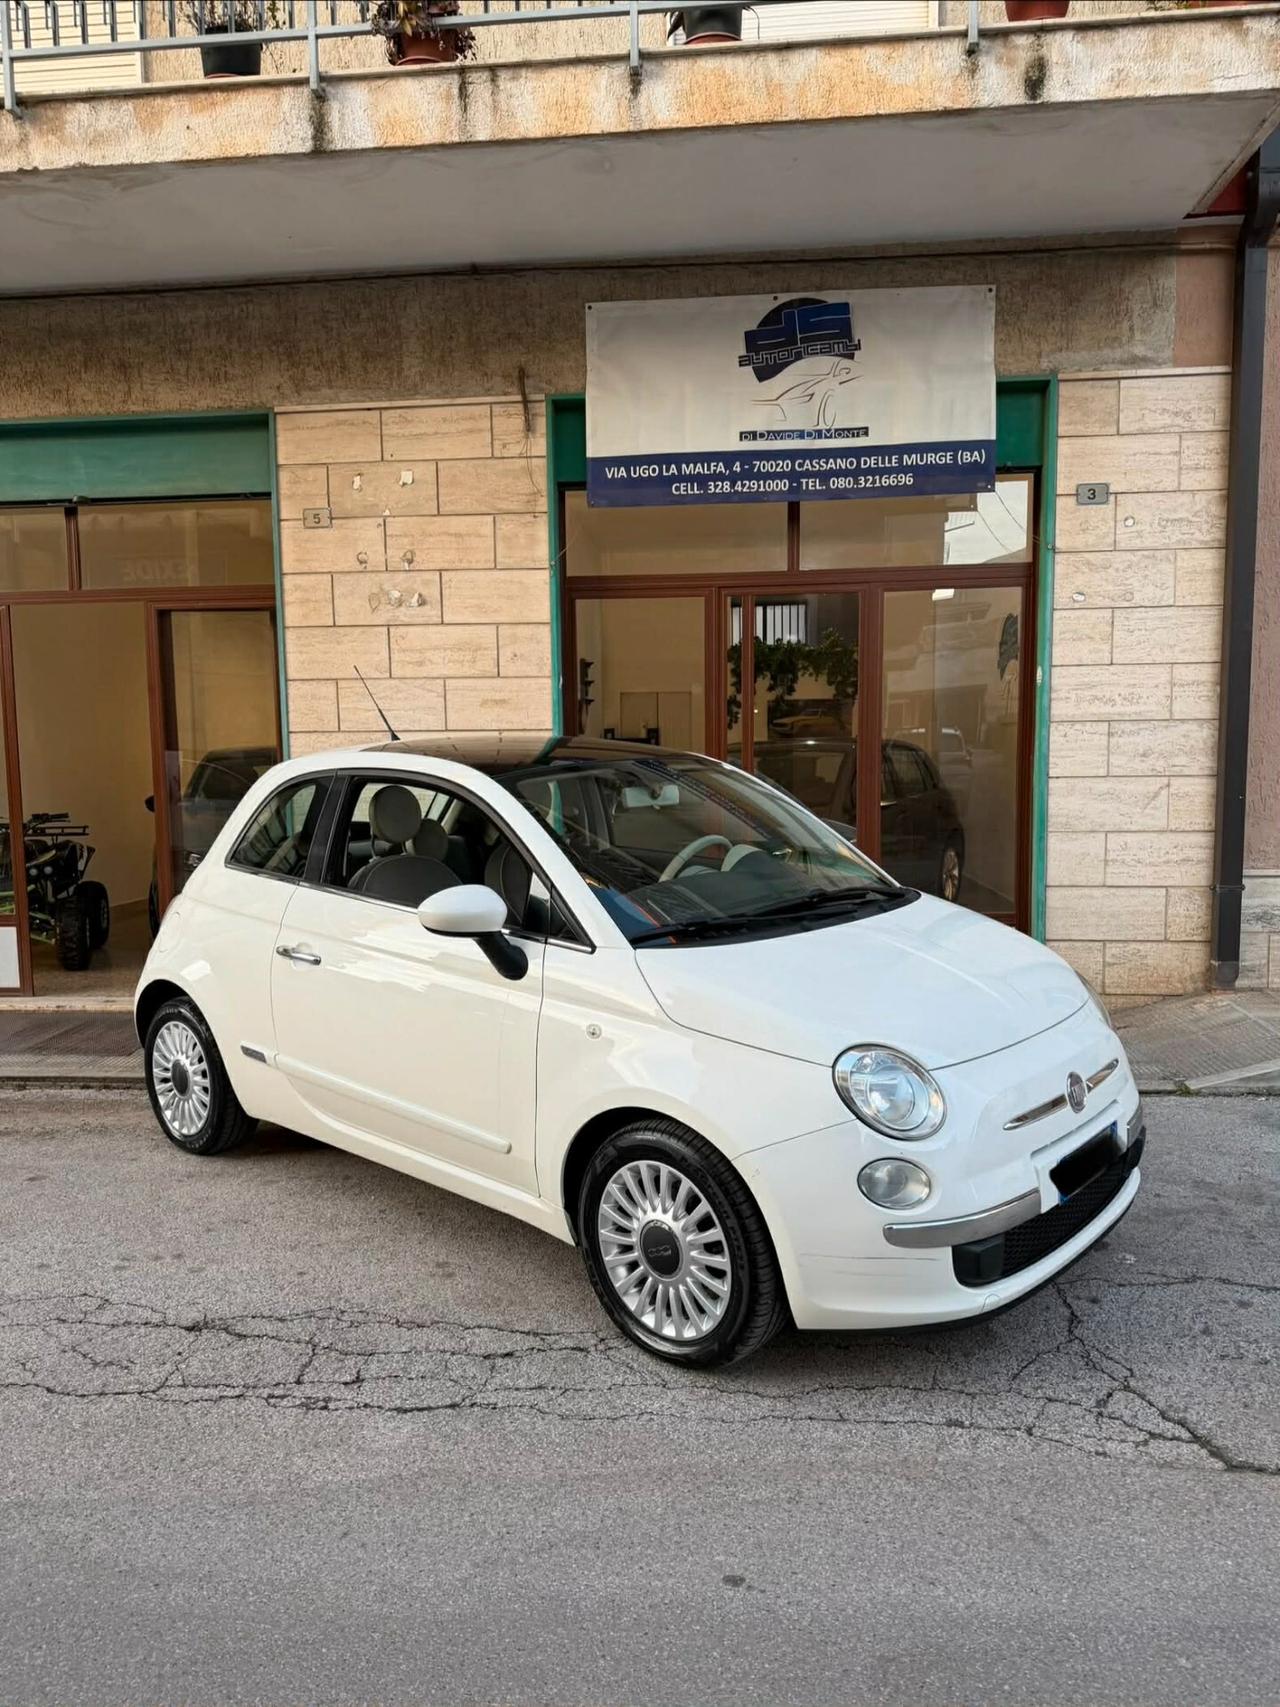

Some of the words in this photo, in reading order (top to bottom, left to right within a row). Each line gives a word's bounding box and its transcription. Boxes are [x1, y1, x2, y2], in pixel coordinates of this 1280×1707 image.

[605, 466, 627, 479] VIA
[630, 464, 659, 478] UGO
[662, 463, 678, 476] LA
[681, 461, 730, 476] MALFA,
[732, 461, 741, 473] 4
[752, 459, 792, 473] 70020
[795, 457, 857, 472] CASSANO
[860, 455, 899, 469] DELLE
[903, 451, 954, 466] MURGE
[957, 449, 986, 465] (BA)
[671, 482, 704, 495] CELL.
[707, 479, 789, 494] 328.4291000
[800, 478, 826, 490] TEL.
[829, 473, 914, 489] 080.3216696
[1087, 488, 1096, 500] 3
[313, 513, 321, 525] 5
